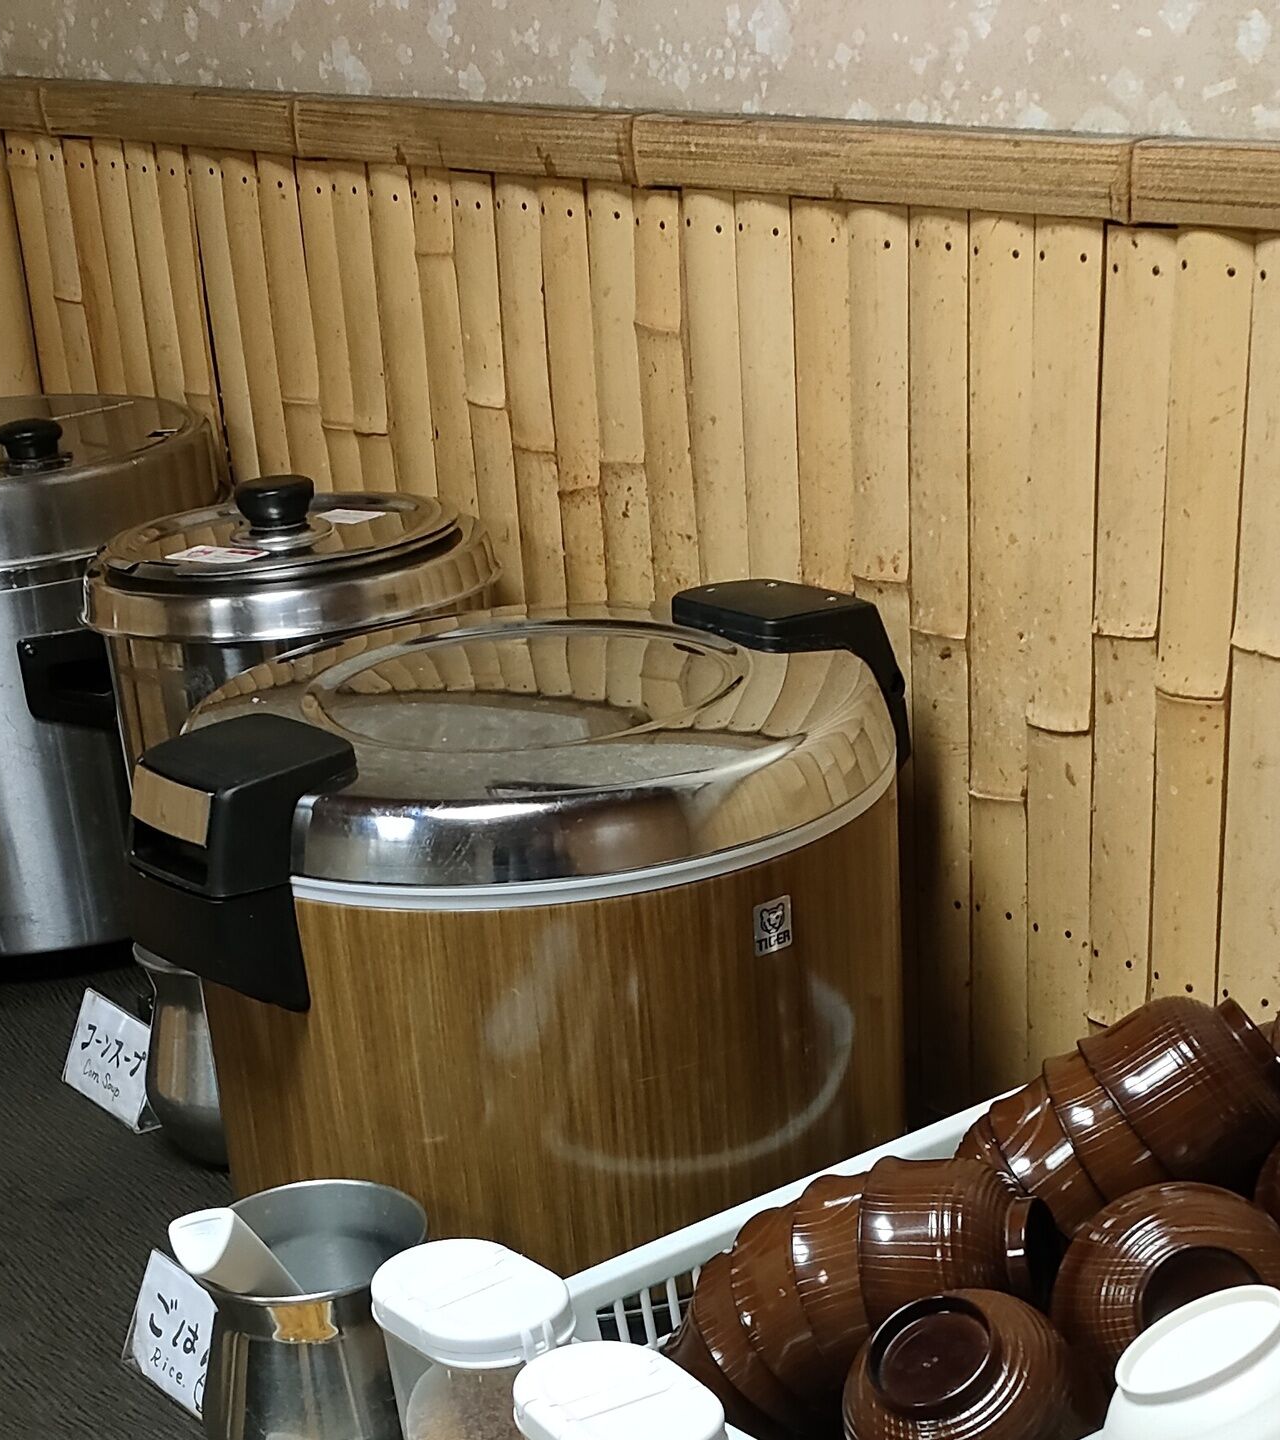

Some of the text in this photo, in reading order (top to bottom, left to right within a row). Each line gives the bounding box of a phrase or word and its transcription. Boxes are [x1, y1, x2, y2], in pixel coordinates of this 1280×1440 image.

[756, 929, 791, 952] TIGER
[81, 1023, 147, 1077] コーンスープ
